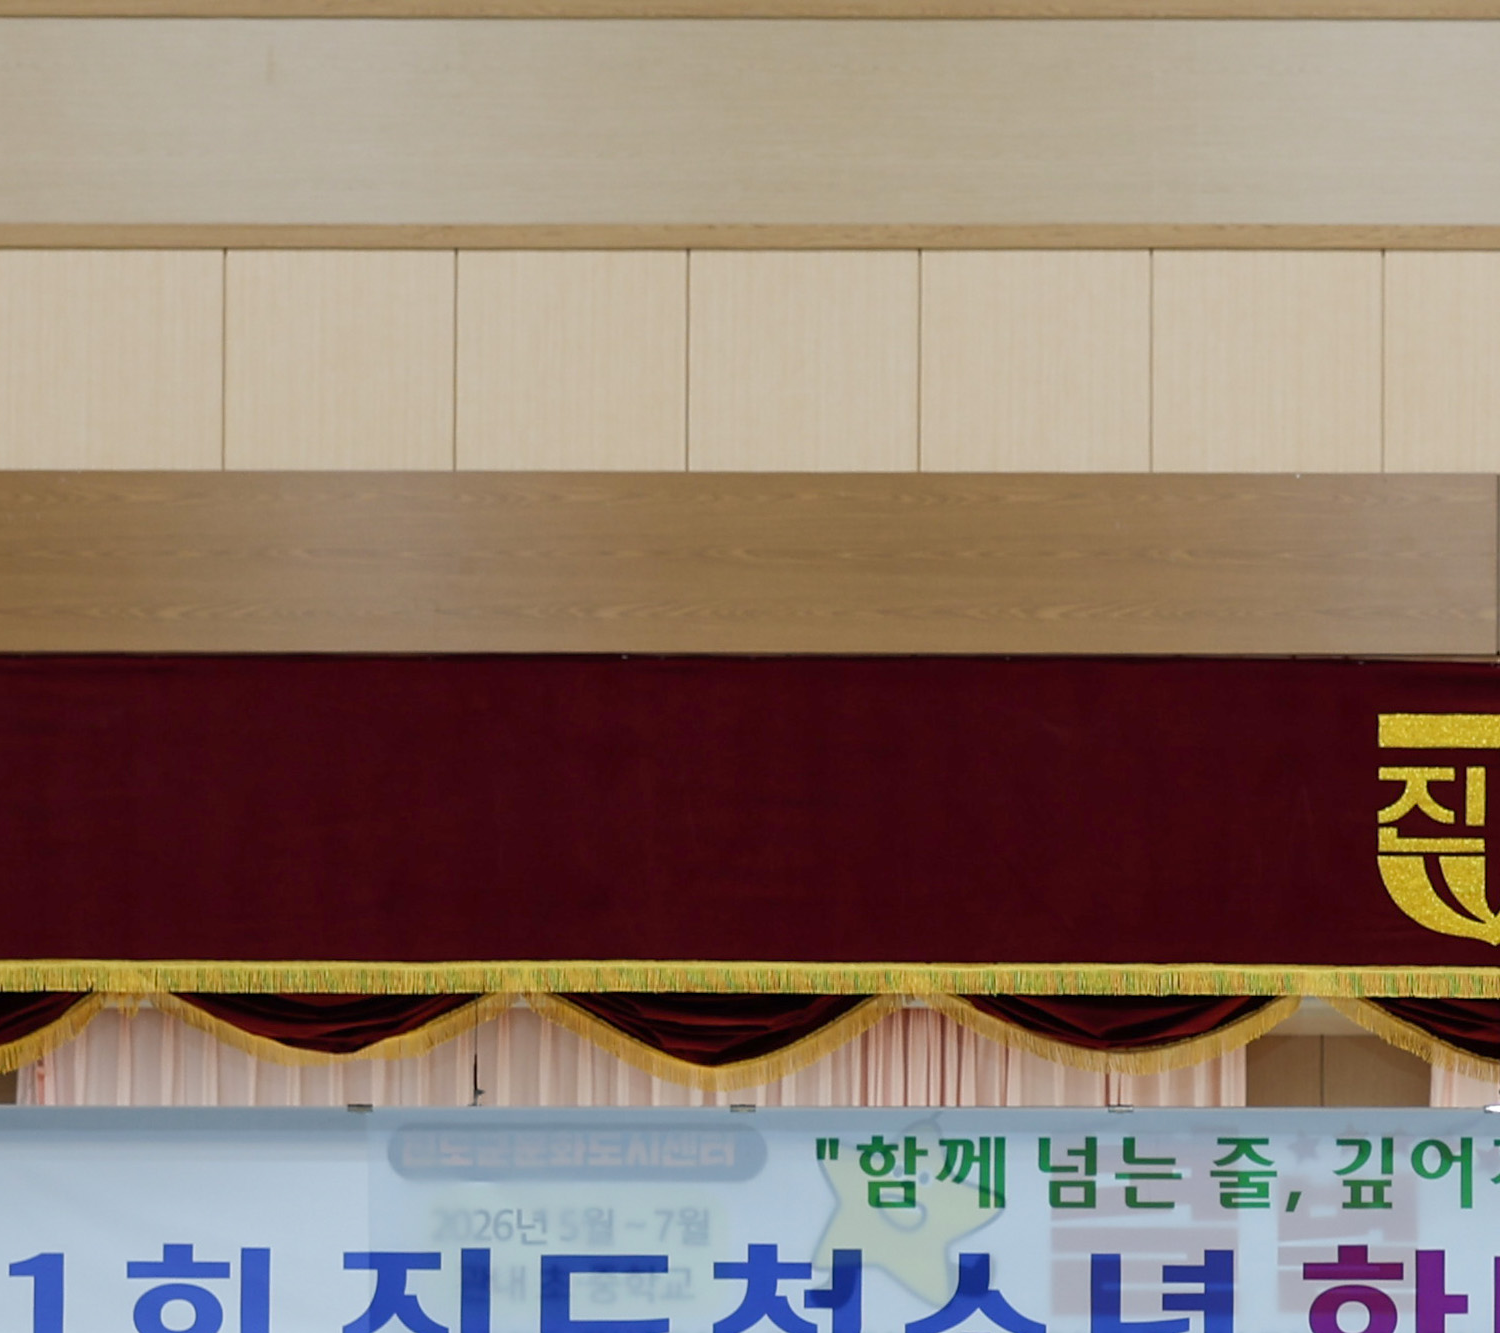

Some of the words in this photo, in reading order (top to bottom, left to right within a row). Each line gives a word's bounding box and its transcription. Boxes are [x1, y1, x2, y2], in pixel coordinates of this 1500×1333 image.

[816, 1136, 1006, 1209] "함께
[1038, 1137, 1181, 1208] 넘는
[1214, 1137, 1299, 1211] 줄,
